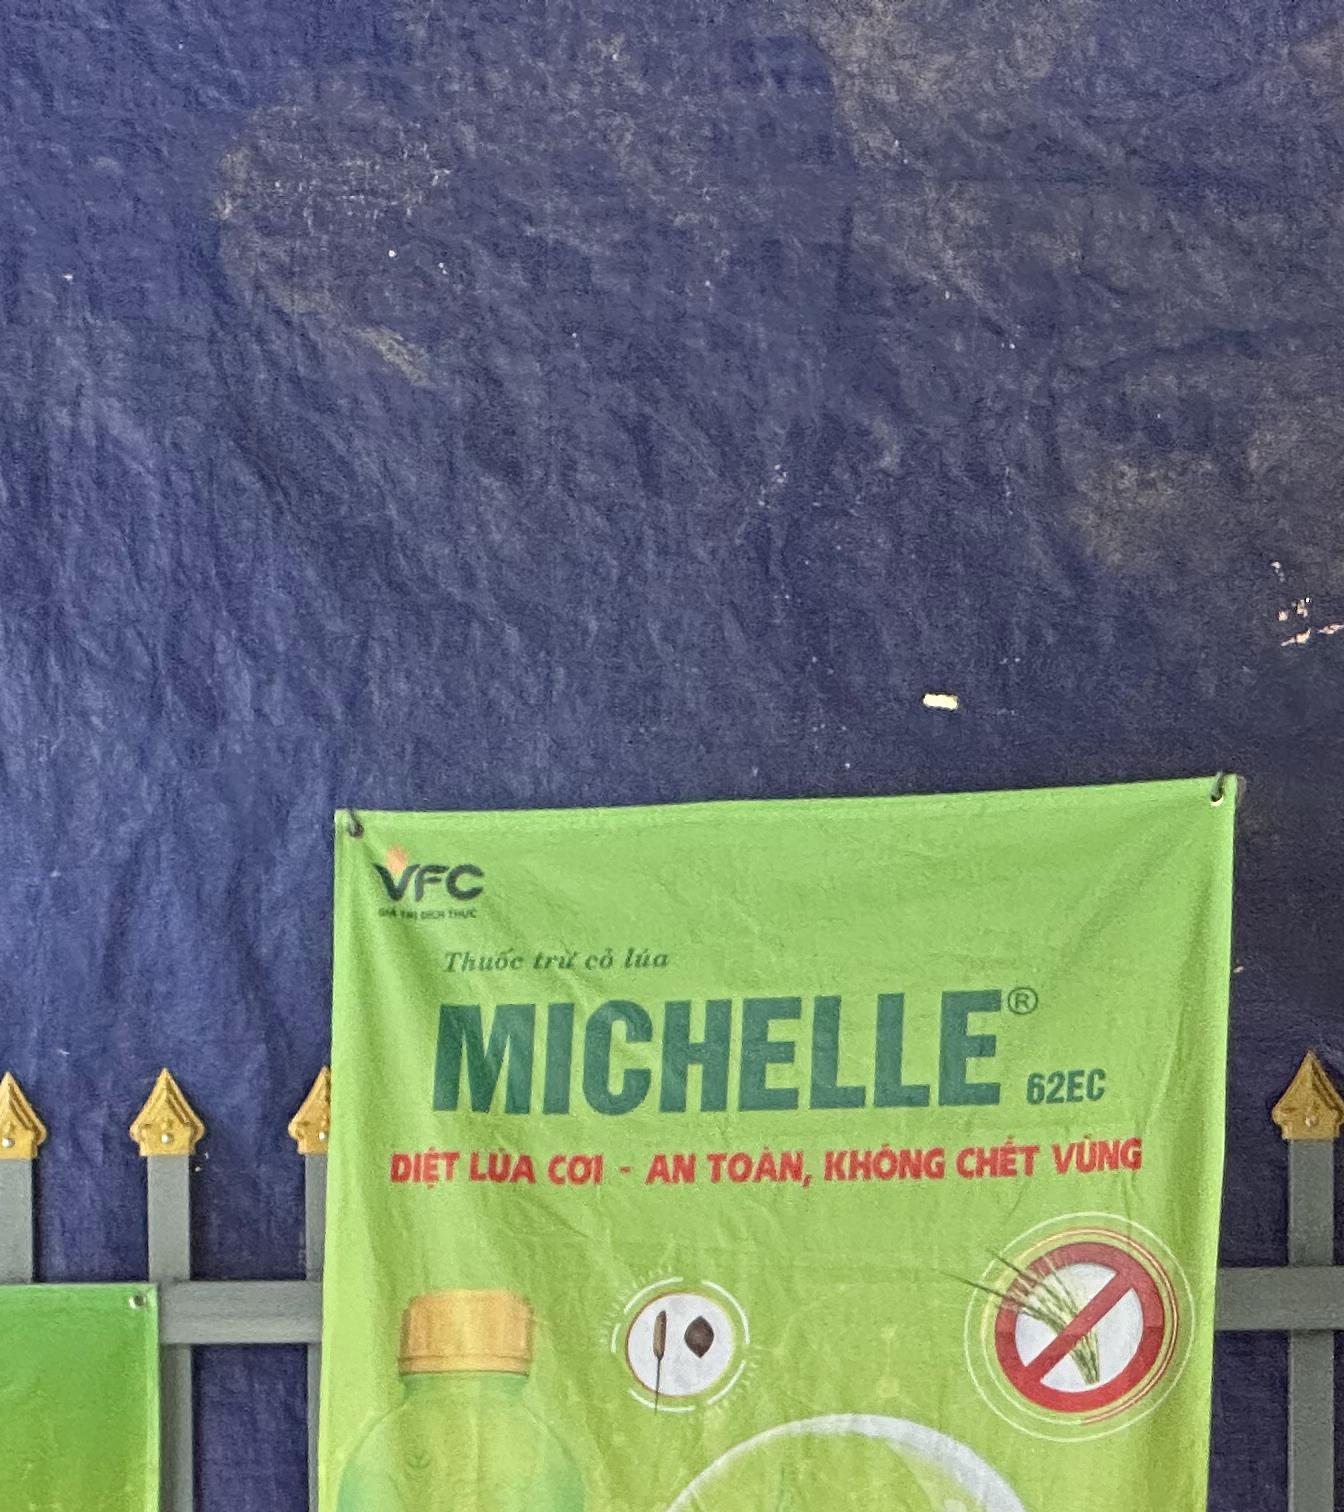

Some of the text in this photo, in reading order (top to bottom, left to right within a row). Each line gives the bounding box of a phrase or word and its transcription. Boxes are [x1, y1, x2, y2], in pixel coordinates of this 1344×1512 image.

[372, 864, 484, 902] VFC
[443, 947, 670, 973] Thuốc trừ cỏ lúa
[1026, 1069, 1106, 1105] 62EC
[391, 1147, 460, 1189] DIỆT
[646, 1153, 696, 1186] AN
[824, 1143, 946, 1182] KHÔNG
[956, 1136, 1040, 1179] CHẾT
